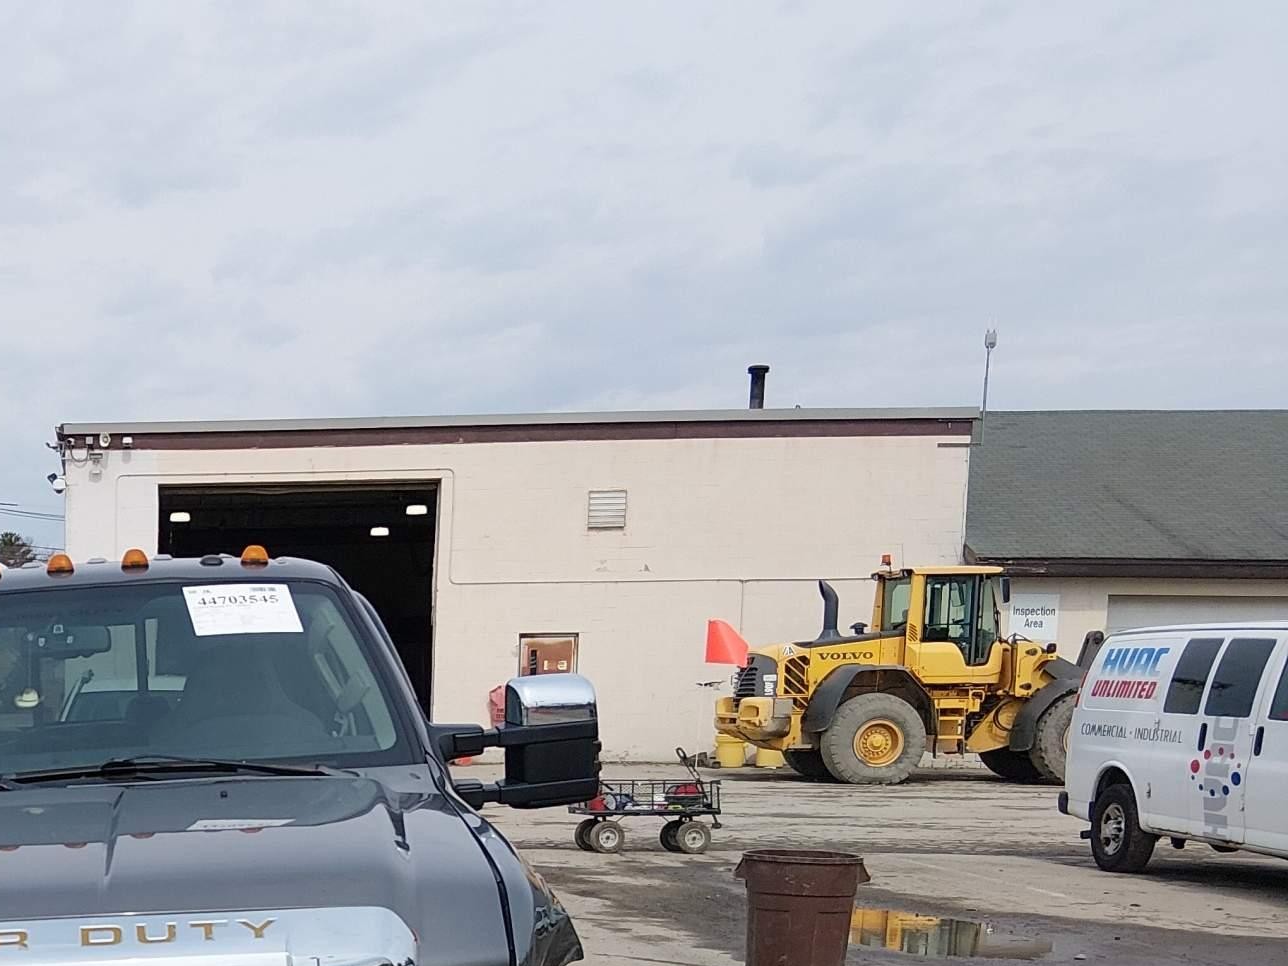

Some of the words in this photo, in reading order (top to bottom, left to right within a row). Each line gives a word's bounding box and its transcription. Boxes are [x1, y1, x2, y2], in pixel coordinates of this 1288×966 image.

[198, 594, 279, 606] 44703545
[1012, 605, 1056, 617] Inspection
[1024, 618, 1044, 628] Area
[818, 651, 874, 661] VOLVO
[1091, 680, 1158, 699] UNLIMITED
[1080, 722, 1127, 738] COMMERCIAL
[1134, 727, 1183, 743] INDUSTRIAL
[79, 917, 278, 948] DUTY
